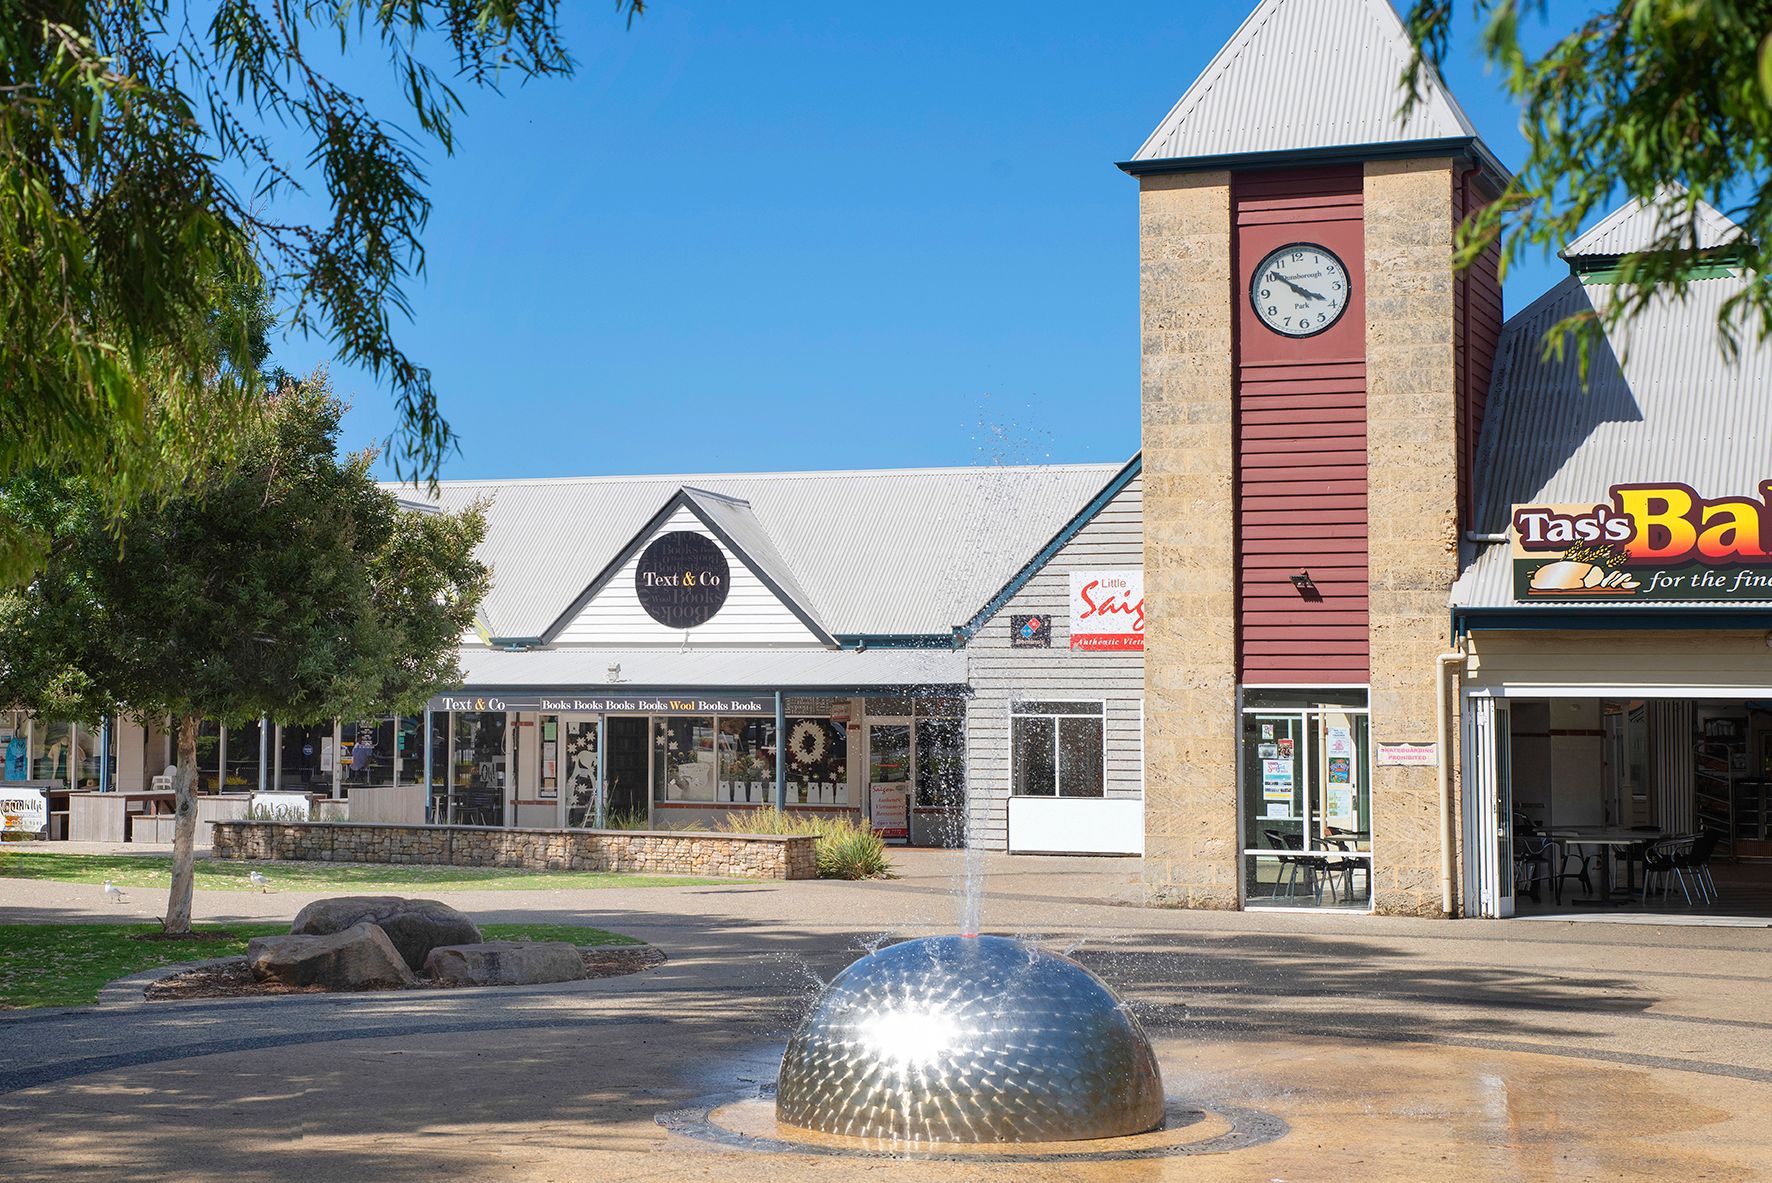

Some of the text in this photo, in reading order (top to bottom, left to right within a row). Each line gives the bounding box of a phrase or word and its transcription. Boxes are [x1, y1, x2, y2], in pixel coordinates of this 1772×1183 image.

[1292, 253, 1304, 262] 12
[1276, 260, 1285, 269] 11
[1326, 266, 1335, 274] 2
[1266, 274, 1276, 282] 10
[1332, 281, 1341, 290] 3
[1261, 289, 1270, 299] 9
[1328, 299, 1338, 308] 4
[1268, 306, 1277, 316] 8
[1284, 316, 1291, 326] 7
[1317, 313, 1326, 322] 5
[1300, 319, 1310, 329] 6
[1520, 487, 1772, 558] Tas's Ba
[643, 571, 720, 587] Text & Co
[1101, 578, 1127, 588] Little
[1643, 570, 1686, 594] for
[1690, 570, 1726, 588] the
[1078, 637, 1120, 646] Authentic
[442, 698, 505, 711] Text & Co
[543, 700, 762, 711] Books Books Books Books Wool Books Books
